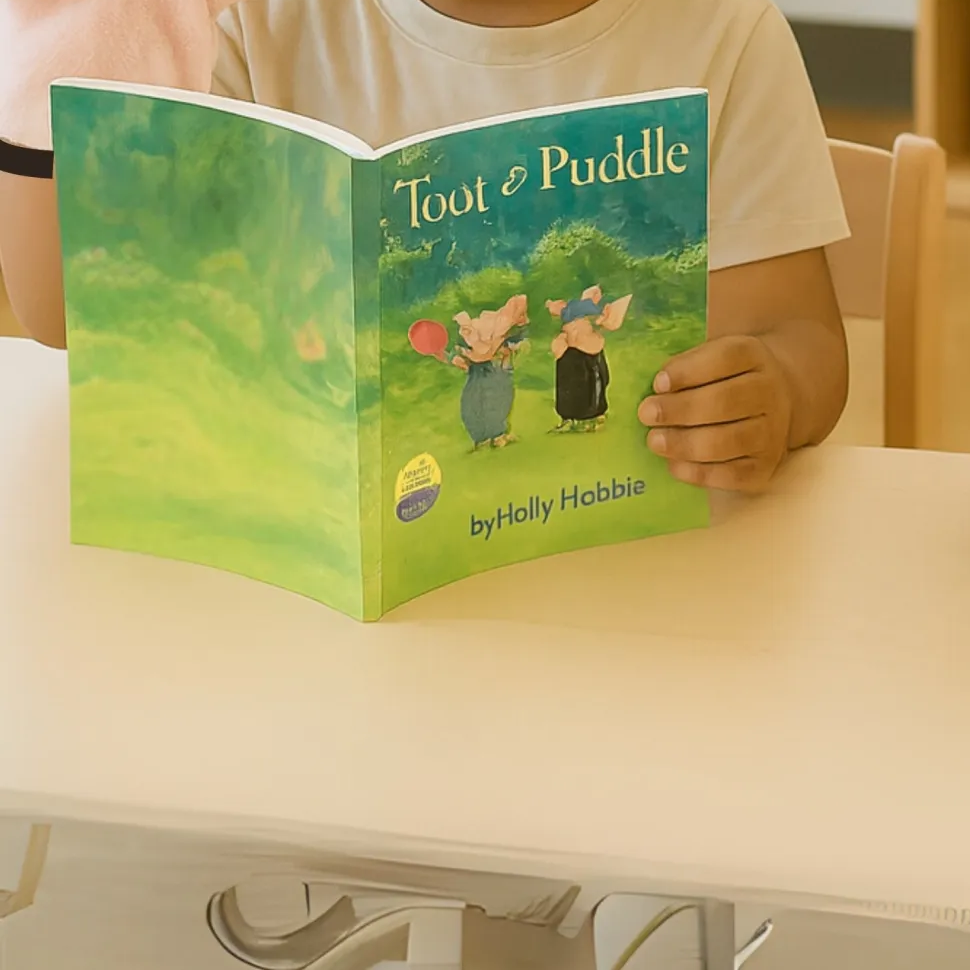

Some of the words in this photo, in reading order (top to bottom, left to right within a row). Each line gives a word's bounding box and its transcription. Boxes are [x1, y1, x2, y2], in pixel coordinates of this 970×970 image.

[393, 173, 490, 229] Toot
[538, 126, 690, 191] Puddle
[560, 476, 647, 511] Hobbie
